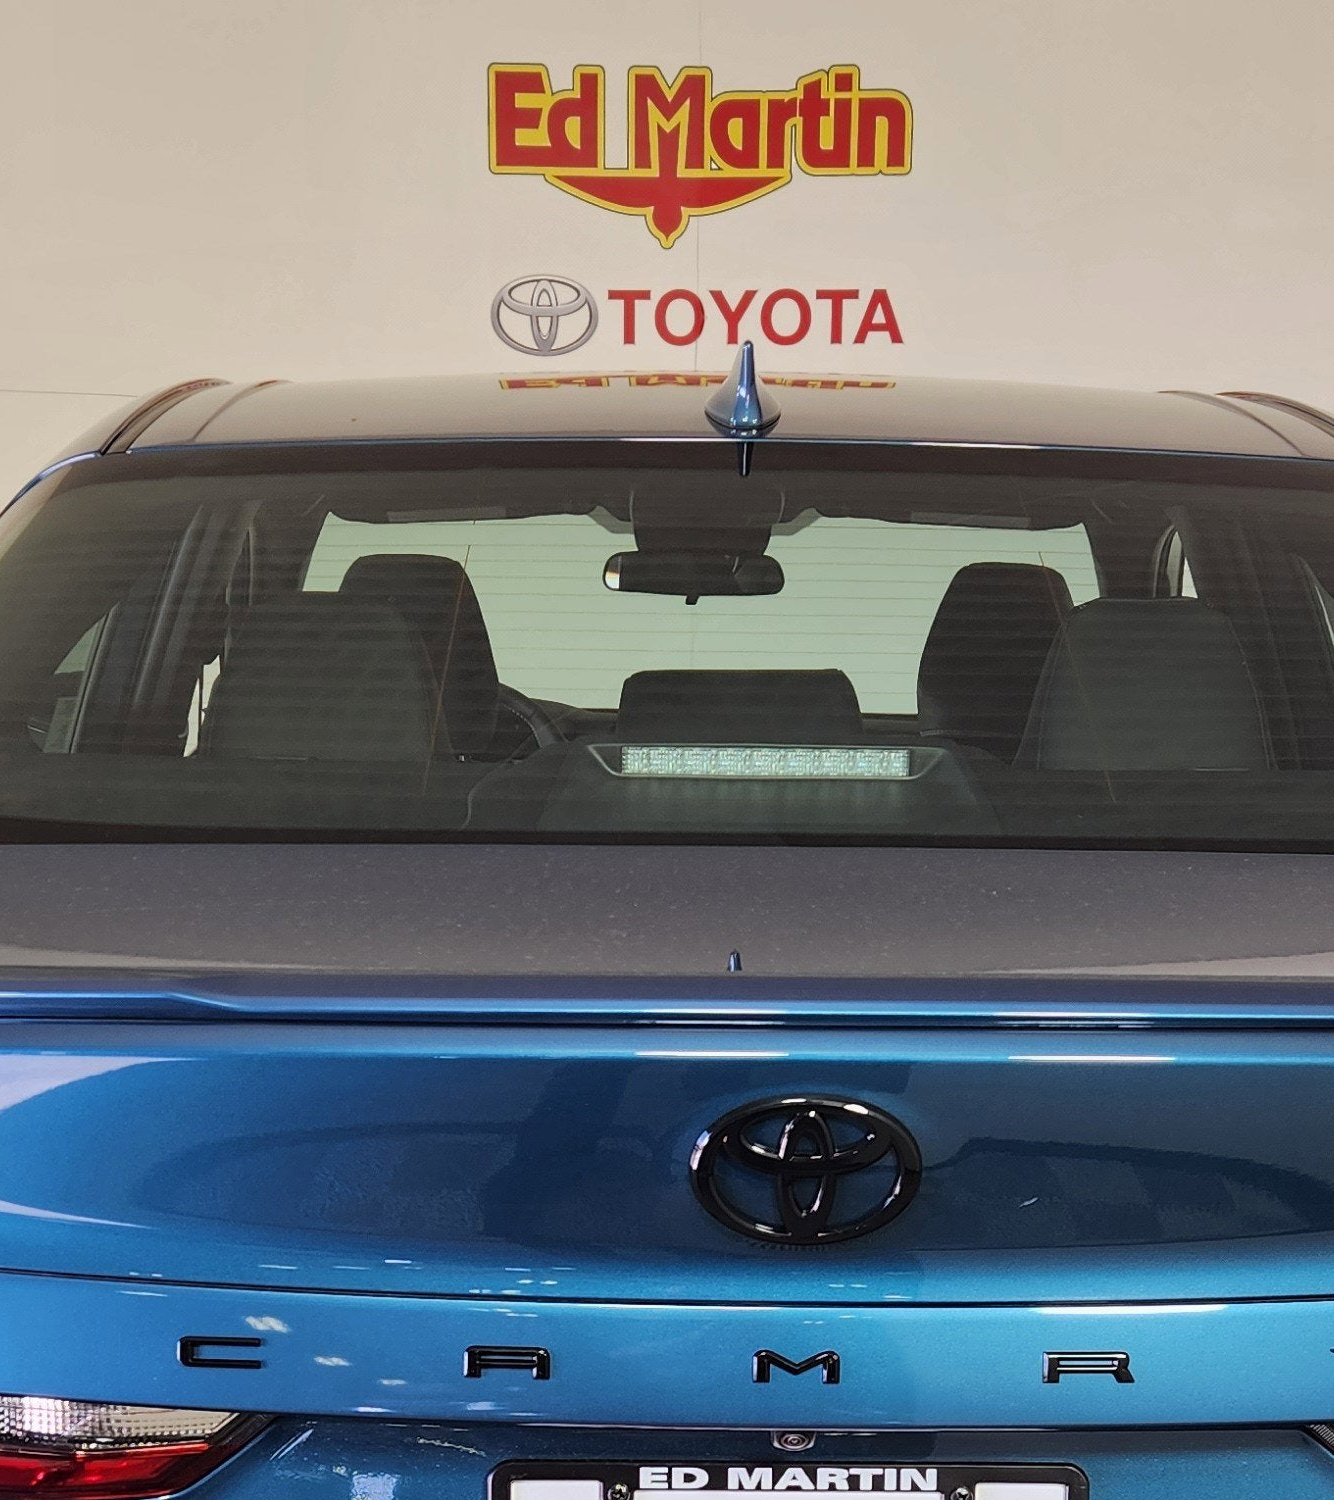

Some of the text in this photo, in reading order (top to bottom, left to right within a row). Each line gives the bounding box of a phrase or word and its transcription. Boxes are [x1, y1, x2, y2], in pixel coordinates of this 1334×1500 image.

[488, 63, 912, 175] Ed Martin
[608, 288, 905, 346] TOYOTA
[638, 1467, 939, 1492] ED MARTIN
